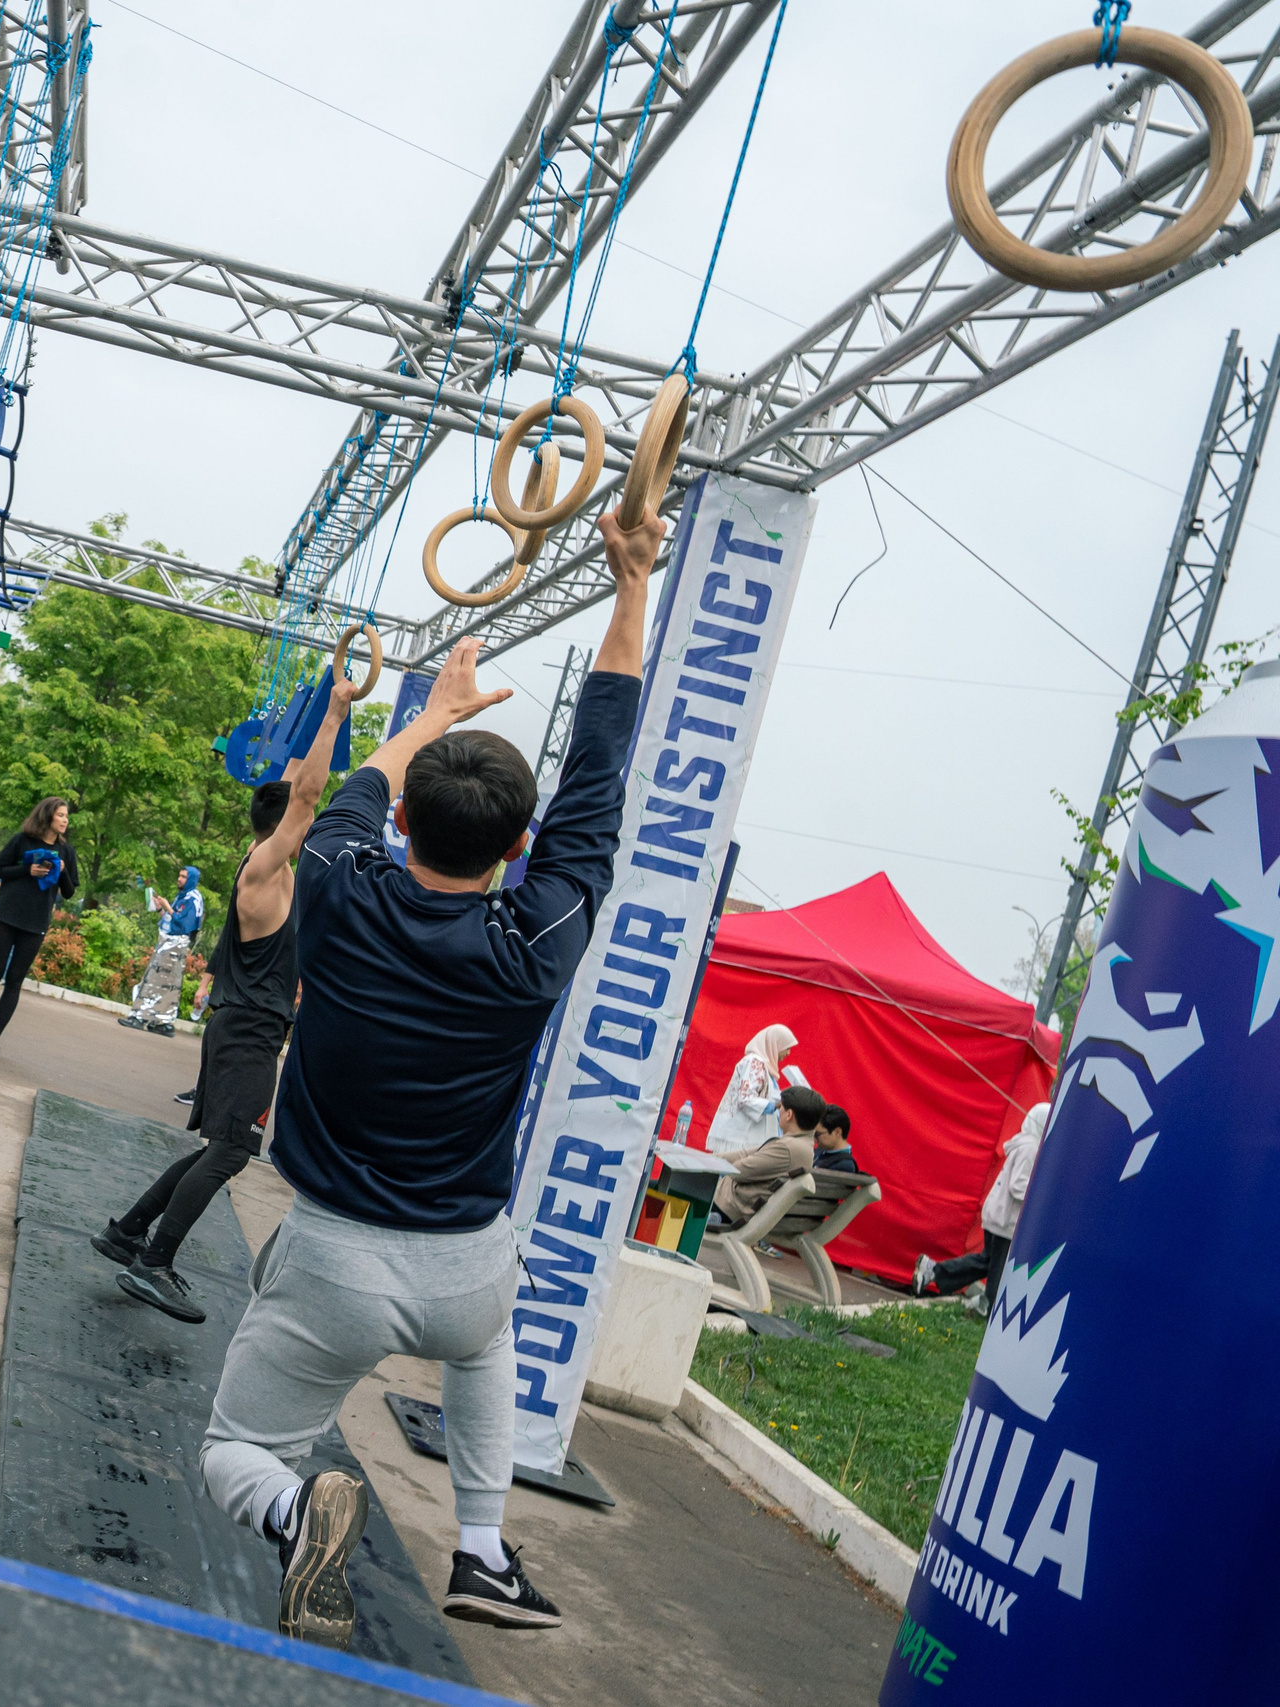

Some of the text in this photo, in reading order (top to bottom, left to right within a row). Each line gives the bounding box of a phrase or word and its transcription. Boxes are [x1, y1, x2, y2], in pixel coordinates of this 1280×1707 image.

[512, 520, 783, 1418] POWER YOUR INSTINCT
[933, 1545, 1019, 1636] DRINK
